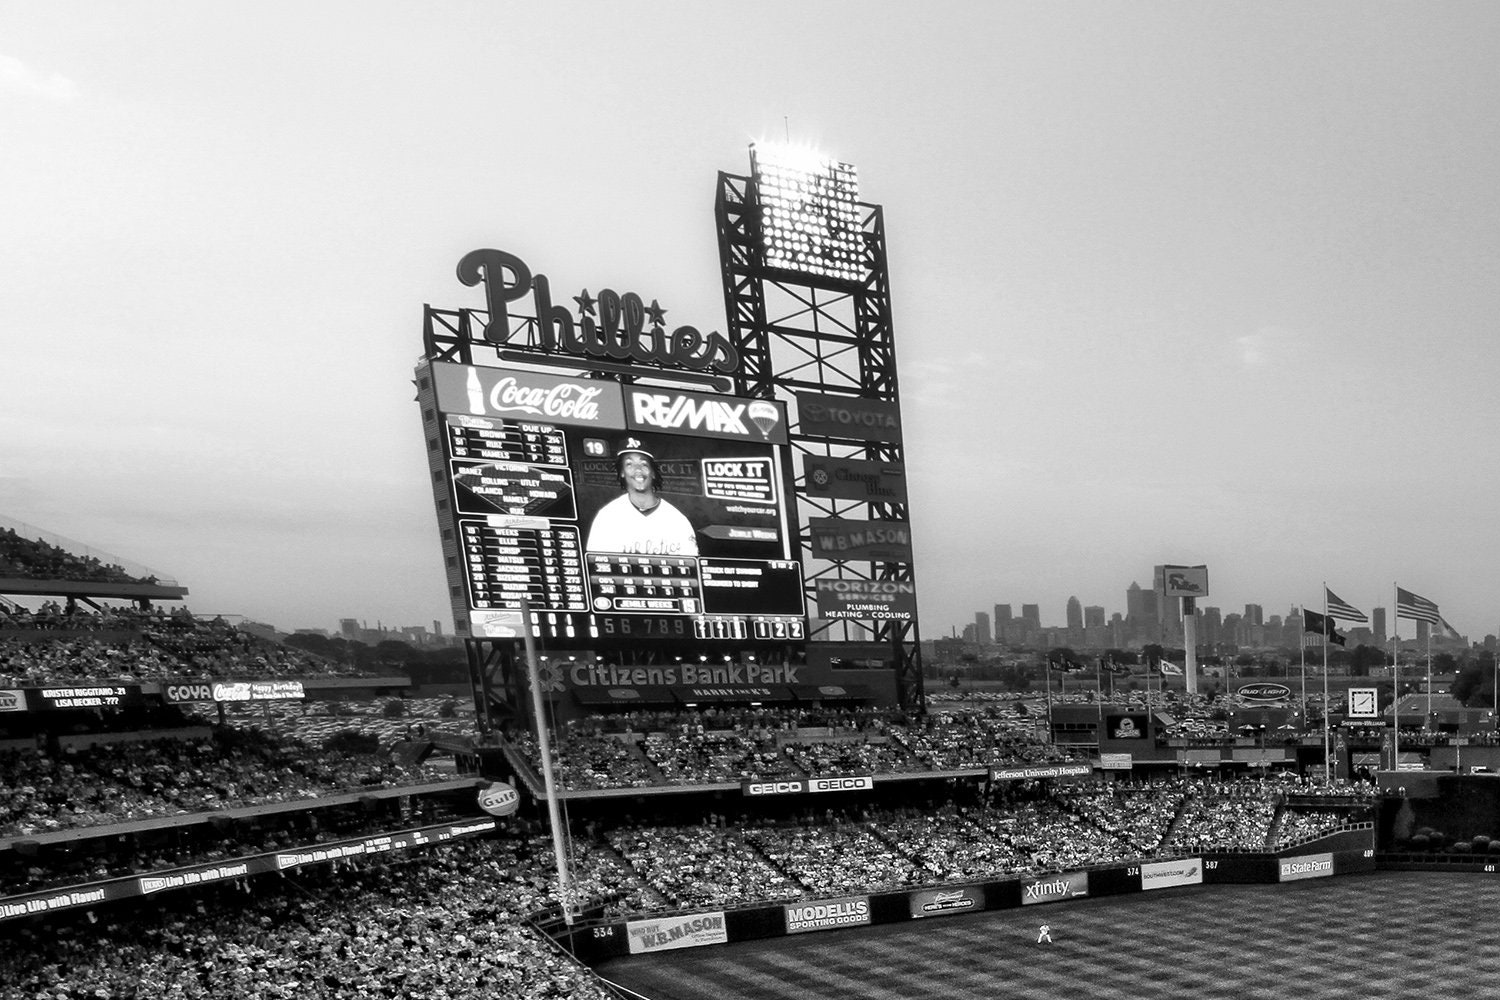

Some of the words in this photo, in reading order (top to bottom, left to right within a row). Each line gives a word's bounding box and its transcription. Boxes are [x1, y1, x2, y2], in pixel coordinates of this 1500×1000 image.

[457, 248, 739, 373] Phillies
[490, 376, 603, 420] Coca-Cola
[632, 392, 750, 434] RE/MAX
[829, 407, 897, 428] TOYOTA
[522, 424, 539, 432] DUE
[540, 425, 552, 433] UP
[586, 441, 604, 454] 19
[707, 463, 744, 477] LOCK
[746, 463, 764, 477] IT
[520, 479, 540, 487] UTLEY
[818, 580, 914, 594] HORIZON
[838, 593, 895, 601] SERVICES
[847, 603, 889, 611] PLUMBING
[872, 611, 910, 619] COOLING
[604, 618, 615, 633] 5
[621, 619, 631, 634] 6
[644, 619, 652, 634] 7
[659, 619, 669, 634] 8
[674, 619, 684, 634] 9
[761, 622, 766, 636] 1
[775, 622, 785, 637] 2
[792, 622, 801, 637] 2
[570, 663, 677, 687] Citizens
[681, 662, 744, 686] Bank
[747, 662, 799, 684] Park
[42, 689, 74, 698] KRISTEN
[167, 685, 211, 701] GOYA
[693, 688, 733, 697] HARRY
[751, 687, 771, 696] K'S
[55, 699, 73, 707] LISA
[74, 698, 101, 707] BECKER
[993, 769, 1024, 780] Jefferson
[1025, 766, 1058, 778] University
[1059, 764, 1089, 777] Hospitals
[749, 782, 802, 795] GEICO
[817, 778, 866, 791] GEICO
[483, 790, 516, 807] Gulf
[1127, 867, 1139, 876] 374
[1205, 860, 1218, 870] 387
[1291, 862, 1310, 874] State
[1311, 860, 1331, 872] Farm
[166, 876, 184, 887] Live
[184, 873, 201, 884] Life
[200, 869, 220, 881] with
[220, 864, 248, 878] Flavor!
[1026, 879, 1070, 900] xfinity
[4, 902, 27, 917] Live
[27, 898, 47, 913] Life
[48, 894, 71, 909] with
[71, 889, 106, 905] Flavor!
[788, 901, 867, 922] MODELL'S
[790, 917, 835, 930] SPORTING
[836, 913, 868, 925] GOODS
[593, 926, 613, 938] 334
